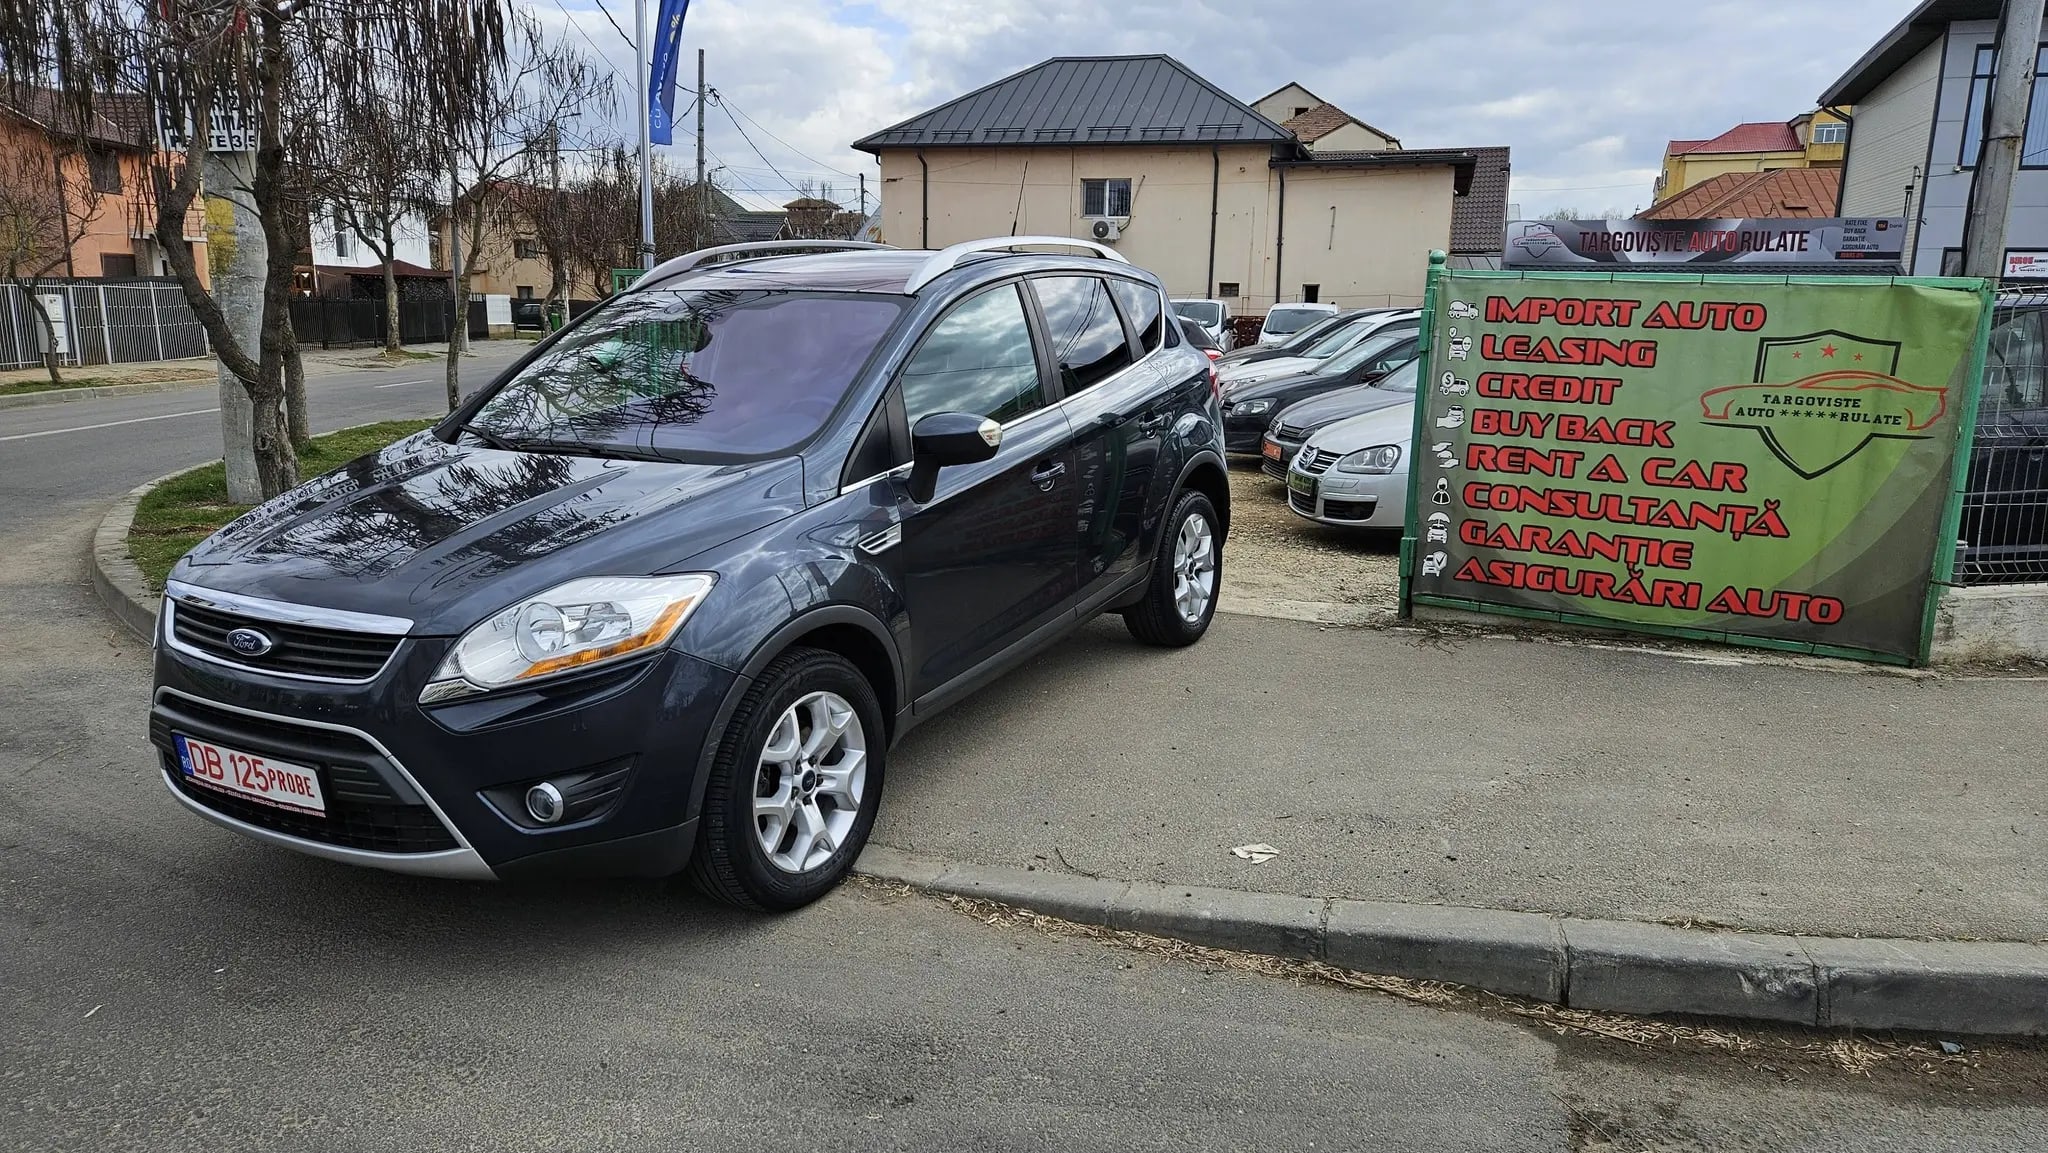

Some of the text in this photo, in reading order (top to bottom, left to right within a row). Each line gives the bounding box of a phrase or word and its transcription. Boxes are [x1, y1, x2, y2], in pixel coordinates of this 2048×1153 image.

[1579, 230, 1810, 257] TARGOVIȘTE AUTO RULATE
[1484, 296, 1767, 332] IMPORT AUTO
[1480, 333, 1658, 368] LEASING
[1475, 371, 1623, 405] CREDIT
[1762, 393, 1862, 408] TARGOVISTE
[1471, 408, 1676, 449] BUY BACK
[1735, 406, 1775, 418] AUTO
[1466, 443, 1748, 494] RENT A CAR
[1463, 481, 1790, 542] CONSULTANȚĂ
[1458, 520, 1694, 571] GARANȚIE
[1453, 556, 1845, 626] ASIGURĂRI AUTO
[233, 633, 256, 650] Ford
[187, 741, 224, 781] DB
